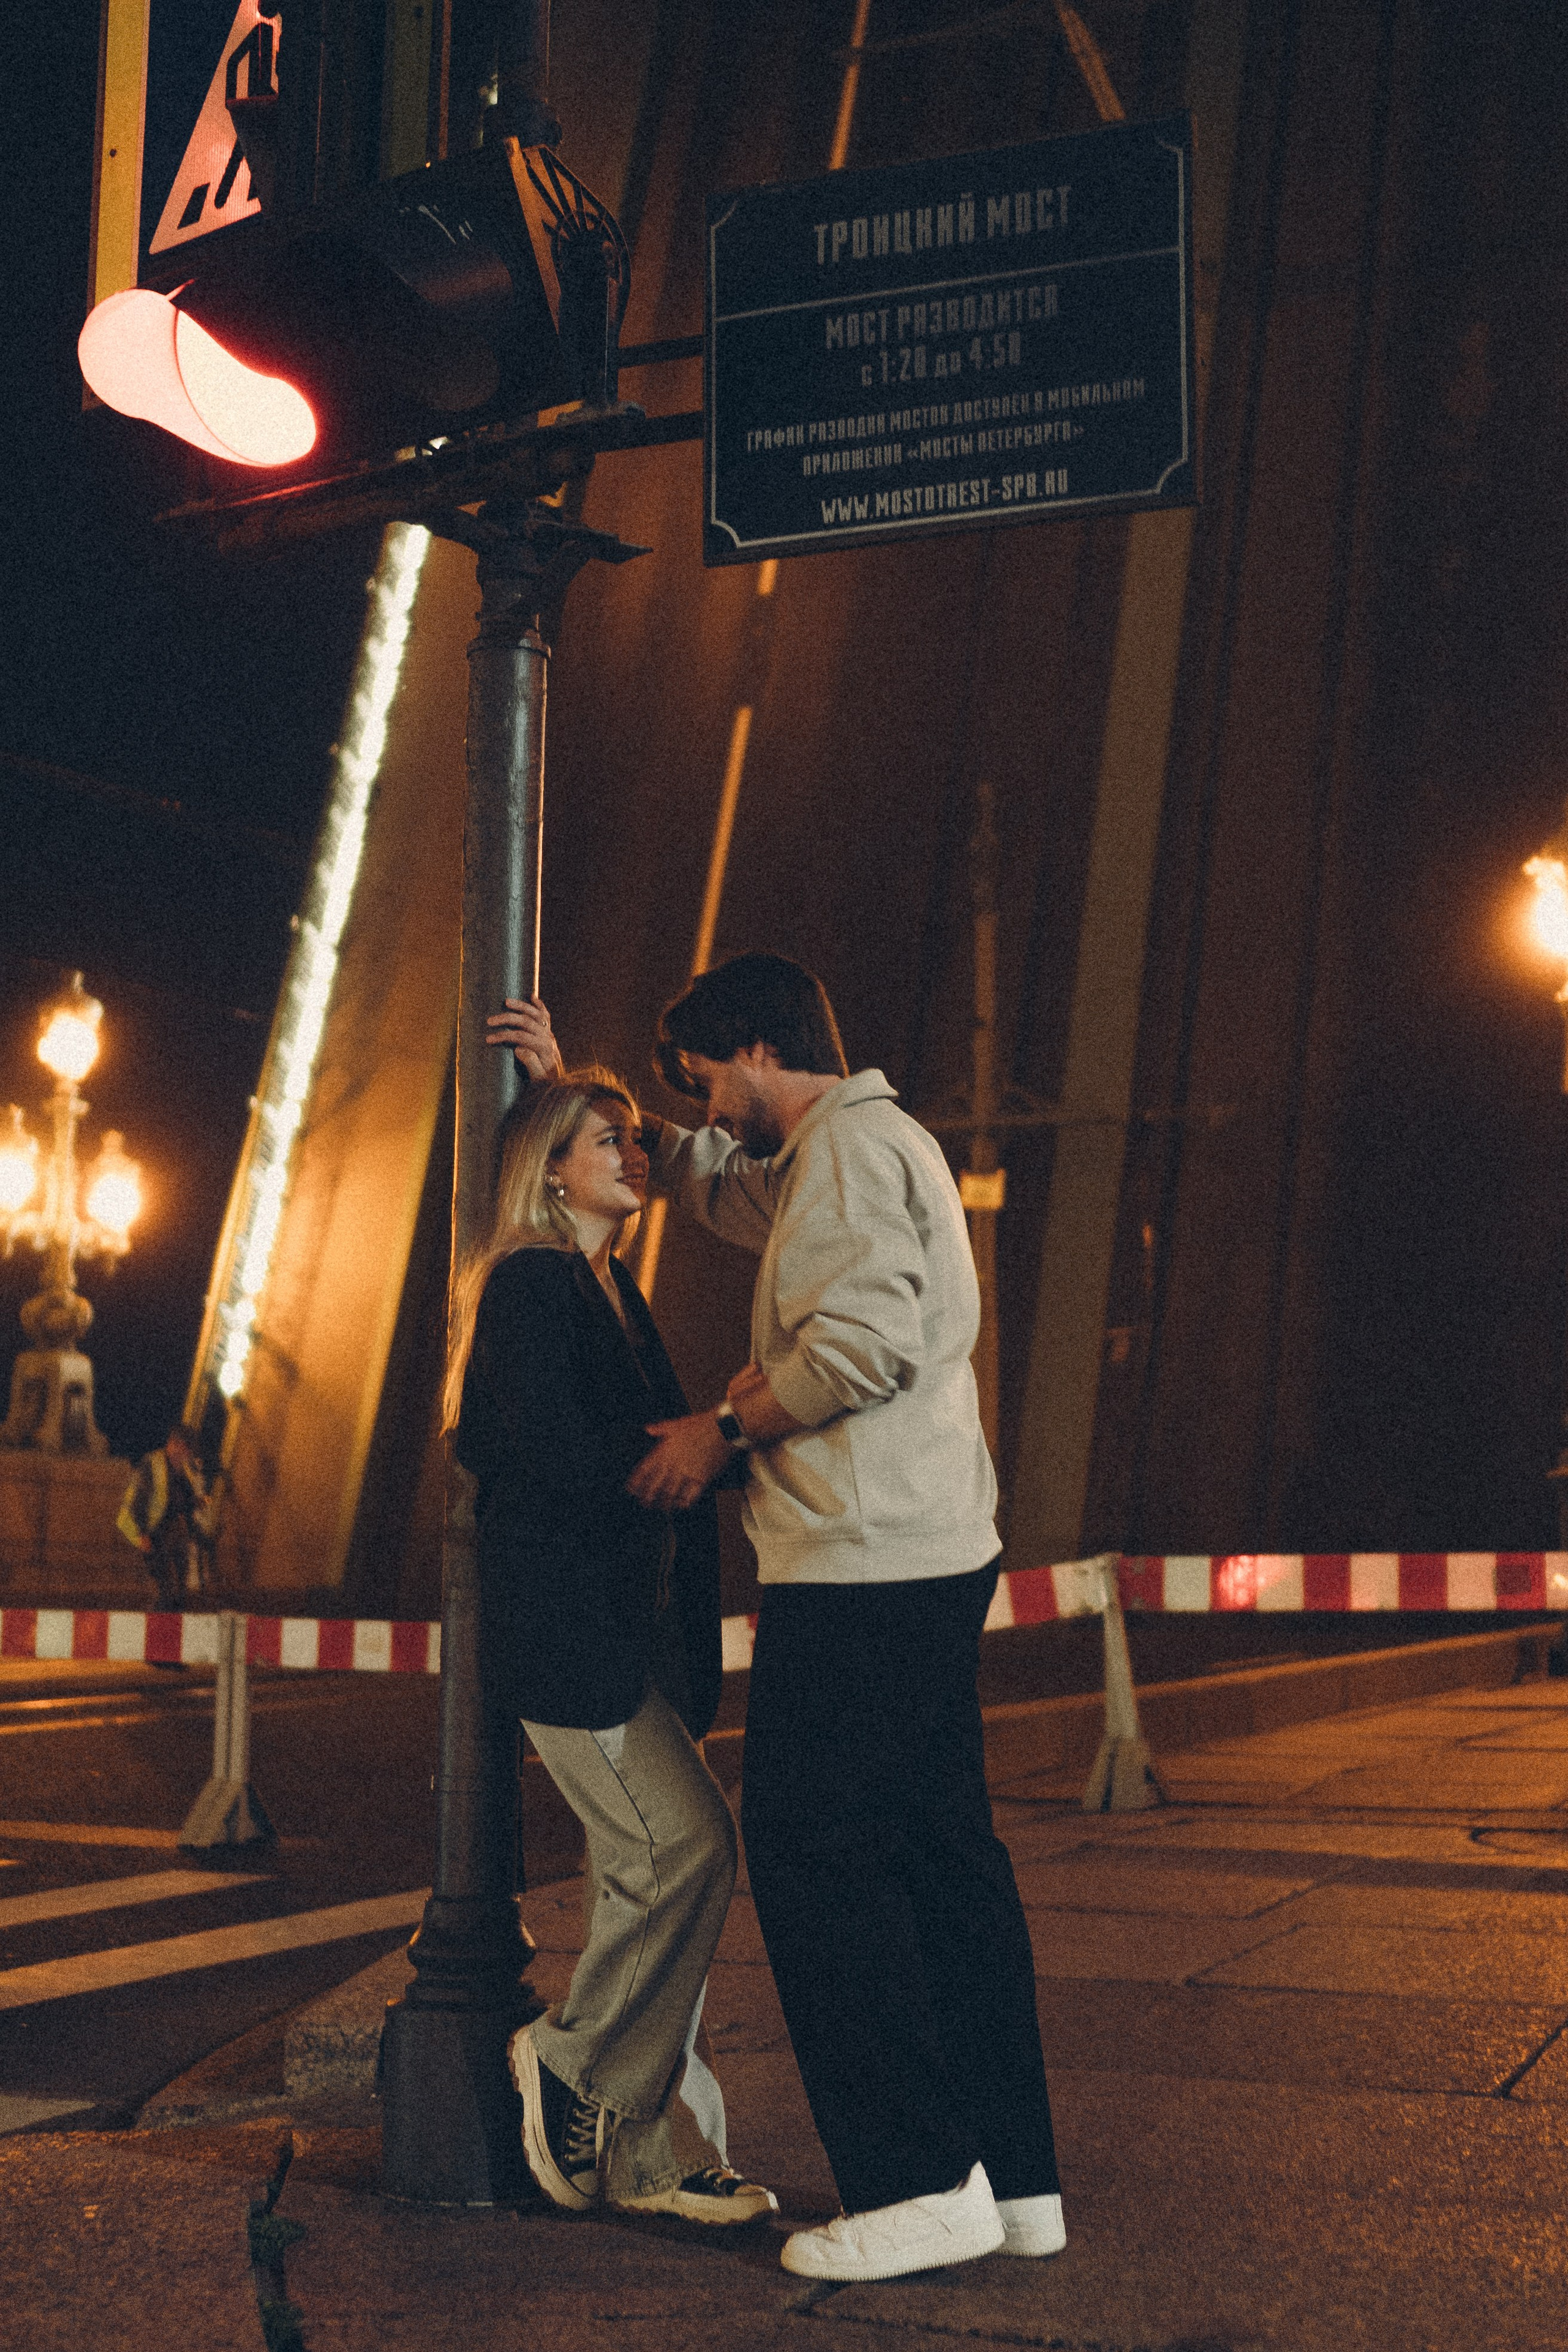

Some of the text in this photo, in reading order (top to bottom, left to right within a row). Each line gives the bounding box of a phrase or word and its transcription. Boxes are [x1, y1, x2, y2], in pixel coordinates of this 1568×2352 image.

[814, 186, 1071, 265] ТРОИЦКИЙ МОСТ
[826, 284, 1058, 350] МОСТ РАЗВОДИТСЯ
[880, 345, 926, 384] 1:20
[934, 351, 961, 378] до
[970, 331, 1021, 370] 4:50
[747, 377, 1145, 452] ГРАФИК РАЗВОДКИ МОСТОВ ДОСТУПЕН В МОБИЛЬНОМ
[803, 420, 1084, 477] ПРИЛОЖЕНИИ «МОСТЫ ПЕТЕРБУРГА»
[821, 469, 1068, 524] WWW.MOSTOTREST-SPB.RU
